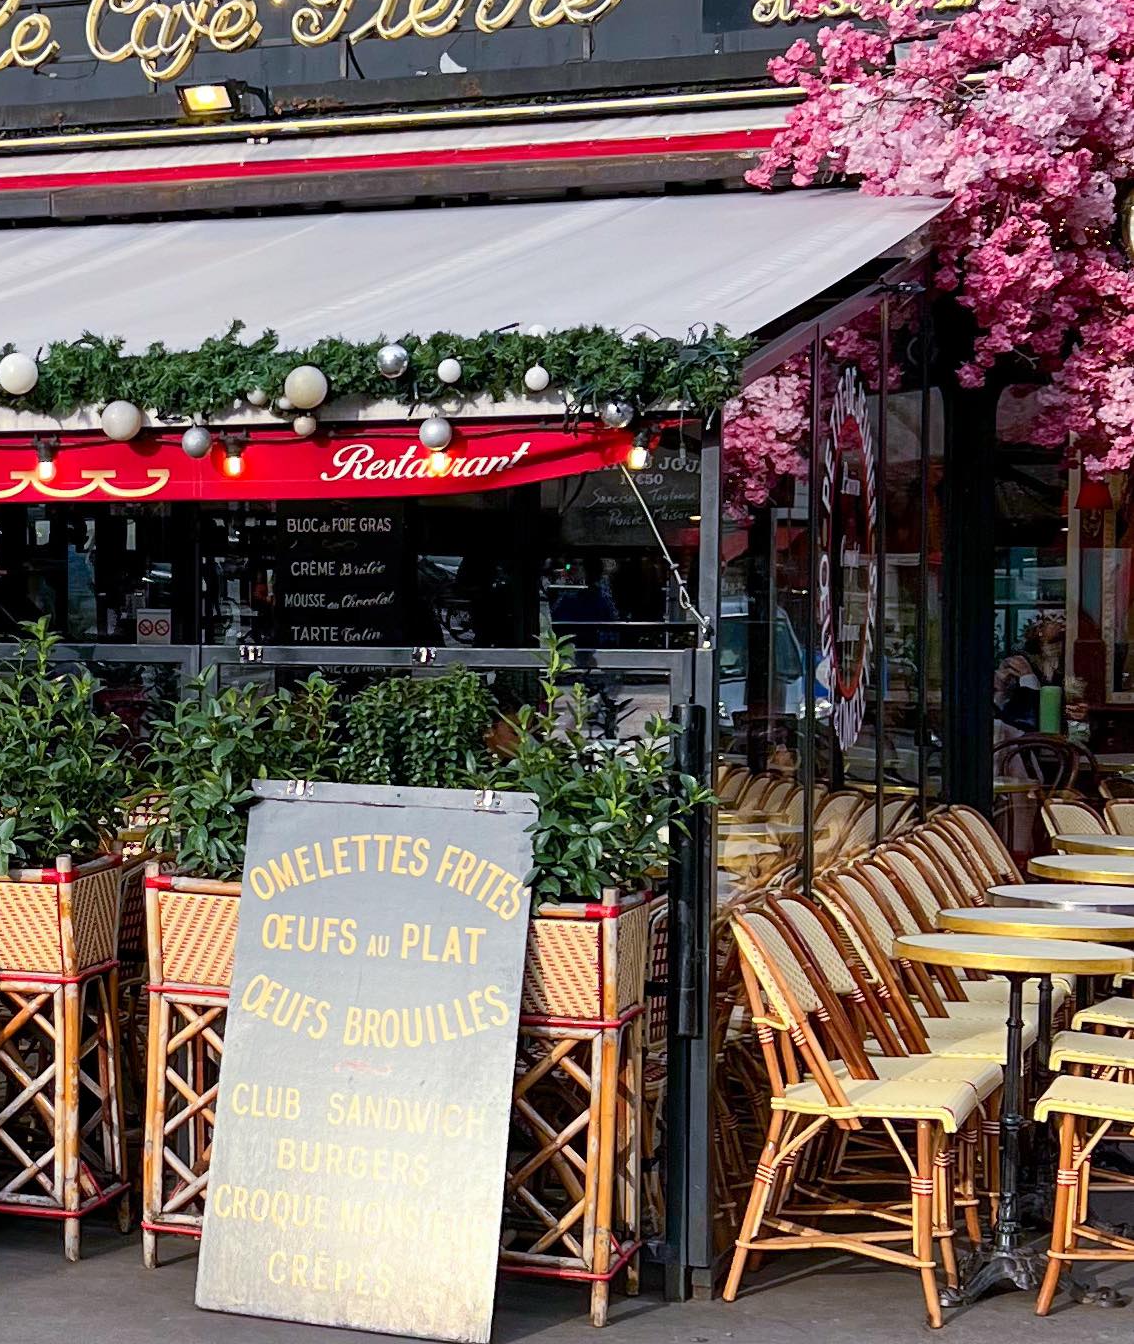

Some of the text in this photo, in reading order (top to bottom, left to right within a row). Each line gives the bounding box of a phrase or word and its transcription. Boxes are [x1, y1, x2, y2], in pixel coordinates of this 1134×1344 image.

[320, 441, 532, 482] Restarant
[286, 518, 319, 533] BLOC
[332, 517, 356, 533] FOIE
[359, 517, 392, 533] GRAS
[284, 592, 327, 608] MOUSSE
[342, 590, 395, 610] Chocolat
[291, 626, 339, 643] TARTE
[248, 834, 526, 921] OMELETTES FRITES
[366, 934, 390, 957] AU
[400, 923, 487, 965] PLAT
[343, 984, 510, 1049] BROUILLES
[231, 1082, 487, 1139] CLUB SANDWICH
[276, 1137, 431, 1187] BURGERS
[214, 1183, 330, 1233] CROQUE
